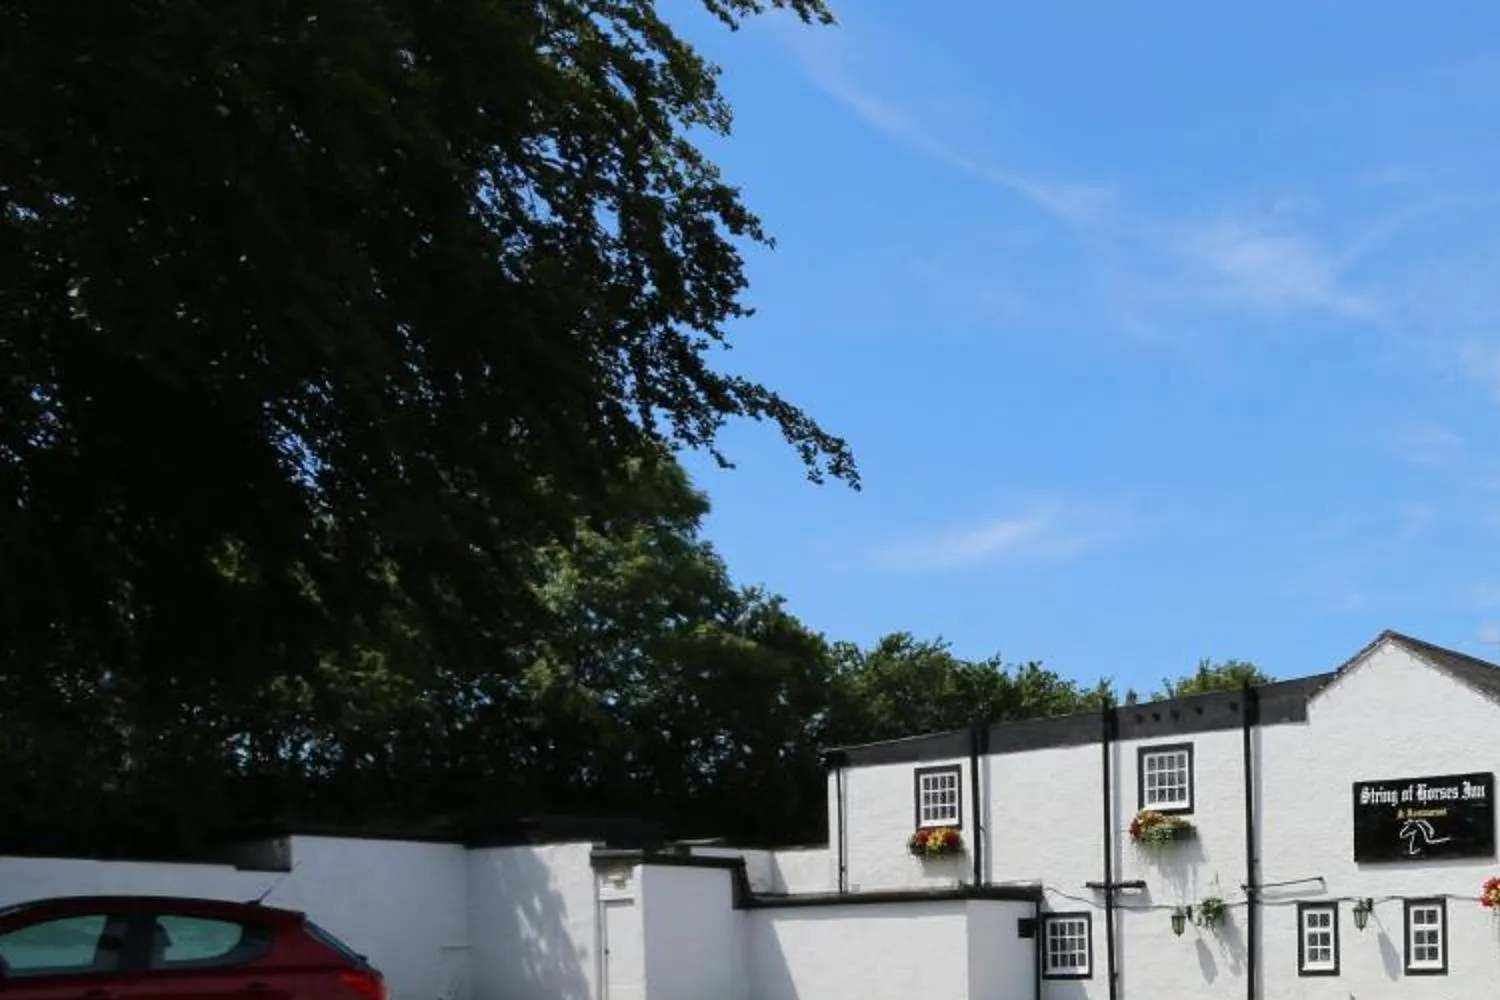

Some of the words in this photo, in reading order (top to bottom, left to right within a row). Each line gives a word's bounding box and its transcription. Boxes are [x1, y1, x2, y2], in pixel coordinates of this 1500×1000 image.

[1360, 785, 1398, 806] String
[1401, 784, 1413, 801] of
[1416, 783, 1459, 804] Horses
[1461, 780, 1486, 800] Inn
